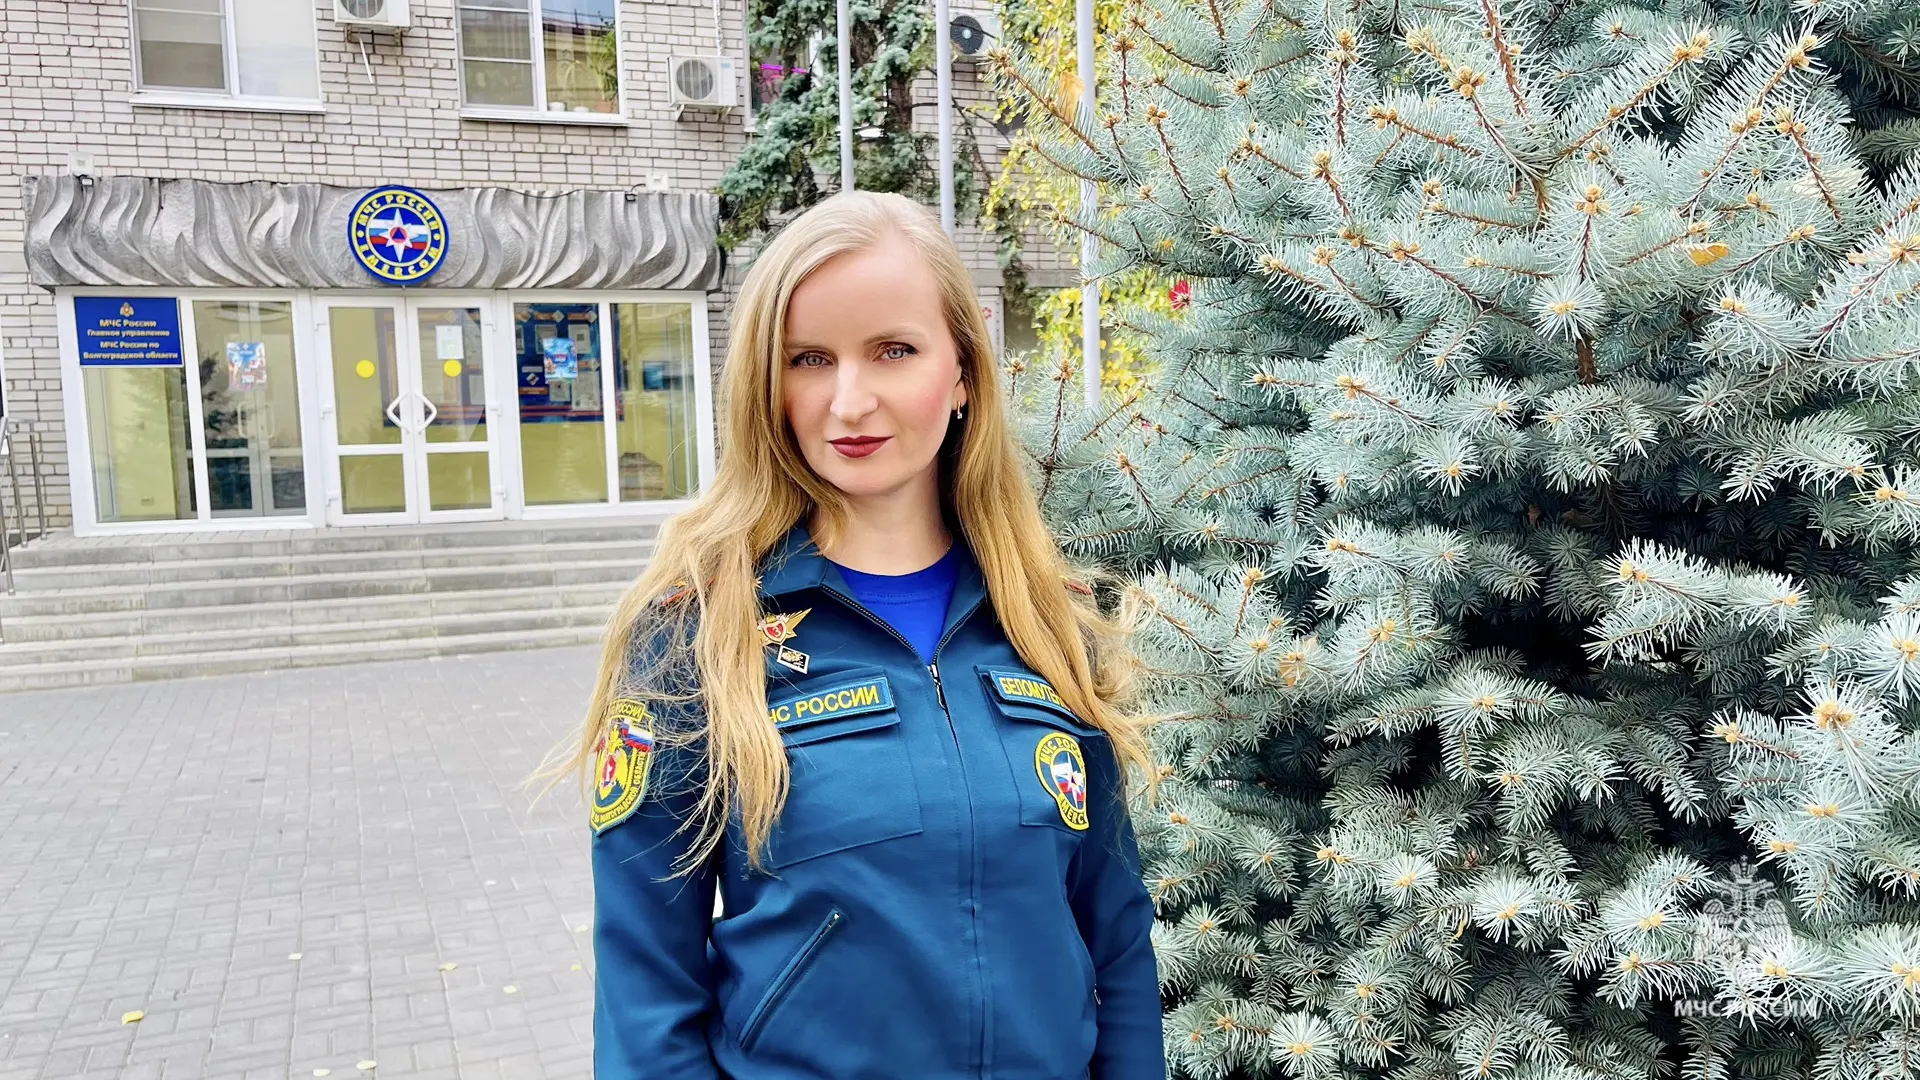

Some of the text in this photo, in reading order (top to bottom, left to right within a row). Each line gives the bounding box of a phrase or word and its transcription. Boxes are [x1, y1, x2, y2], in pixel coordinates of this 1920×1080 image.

[358, 194, 439, 230] МЧС РОССИИ
[359, 244, 439, 276] EMERCOM
[99, 319, 157, 328] МЧС России
[87, 329, 170, 338] Главное управление
[100, 341, 119, 349] МЧС
[120, 341, 148, 349] России
[83, 351, 178, 360] Волгоградской области
[768, 685, 880, 723] ЧС РОССИИ
